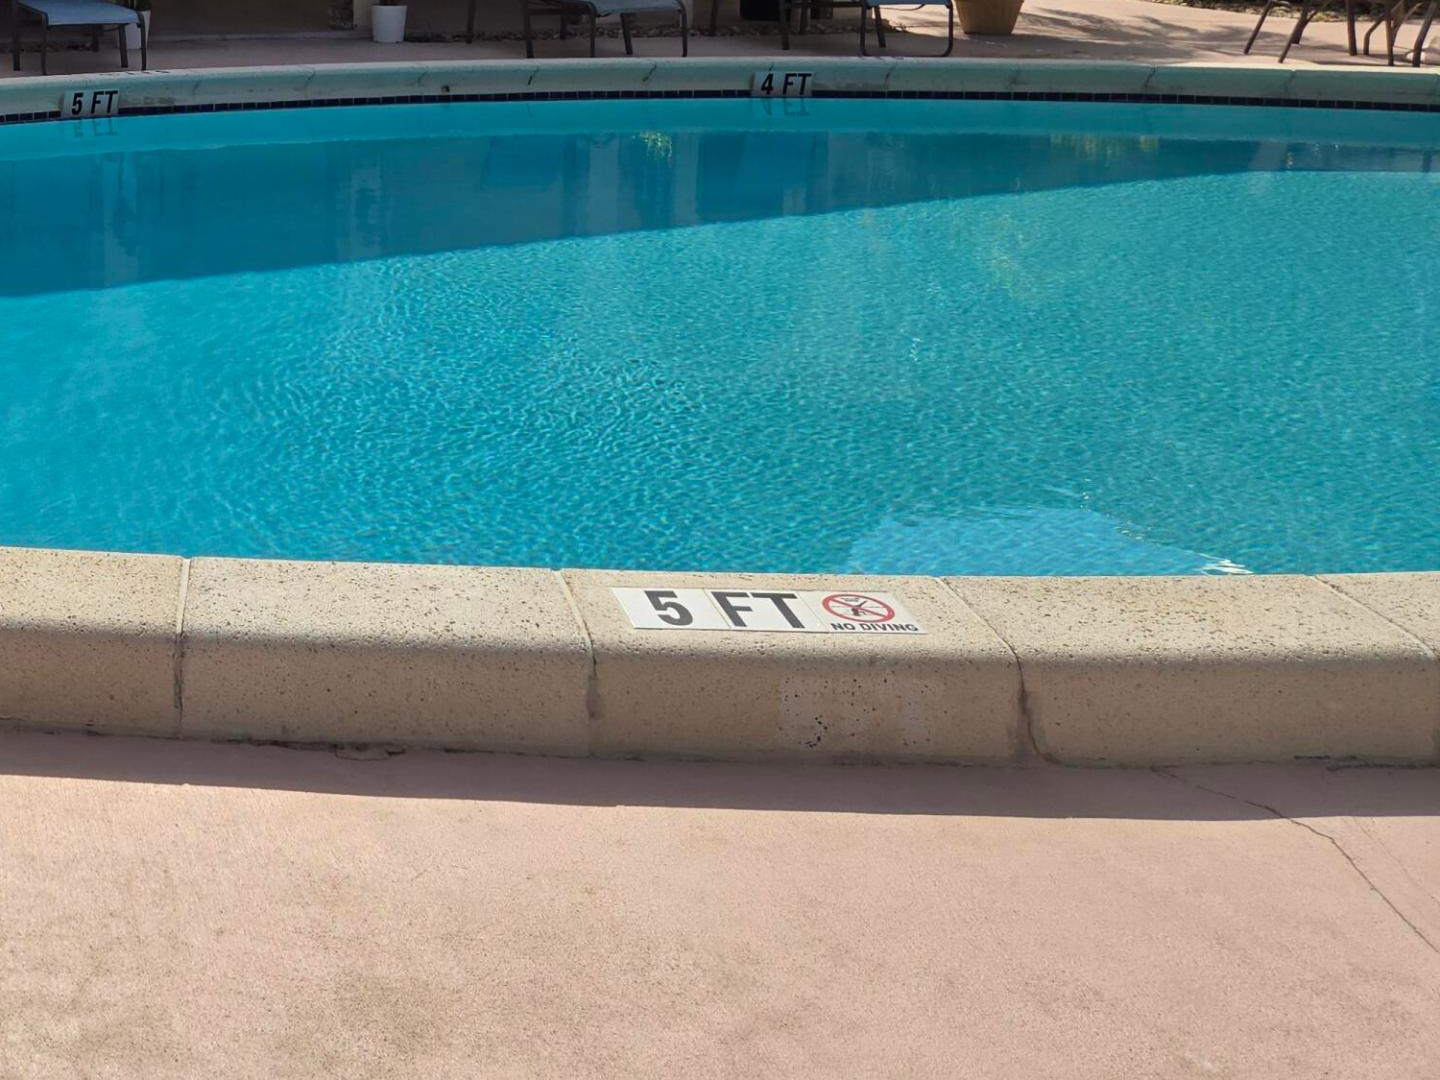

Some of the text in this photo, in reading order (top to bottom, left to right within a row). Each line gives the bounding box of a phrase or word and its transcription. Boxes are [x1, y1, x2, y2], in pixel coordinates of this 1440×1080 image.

[761, 72, 812, 95] 4 FT
[71, 90, 118, 115] 5 FT
[643, 590, 805, 629] 5 FT
[830, 622, 919, 632] NO DIVING
